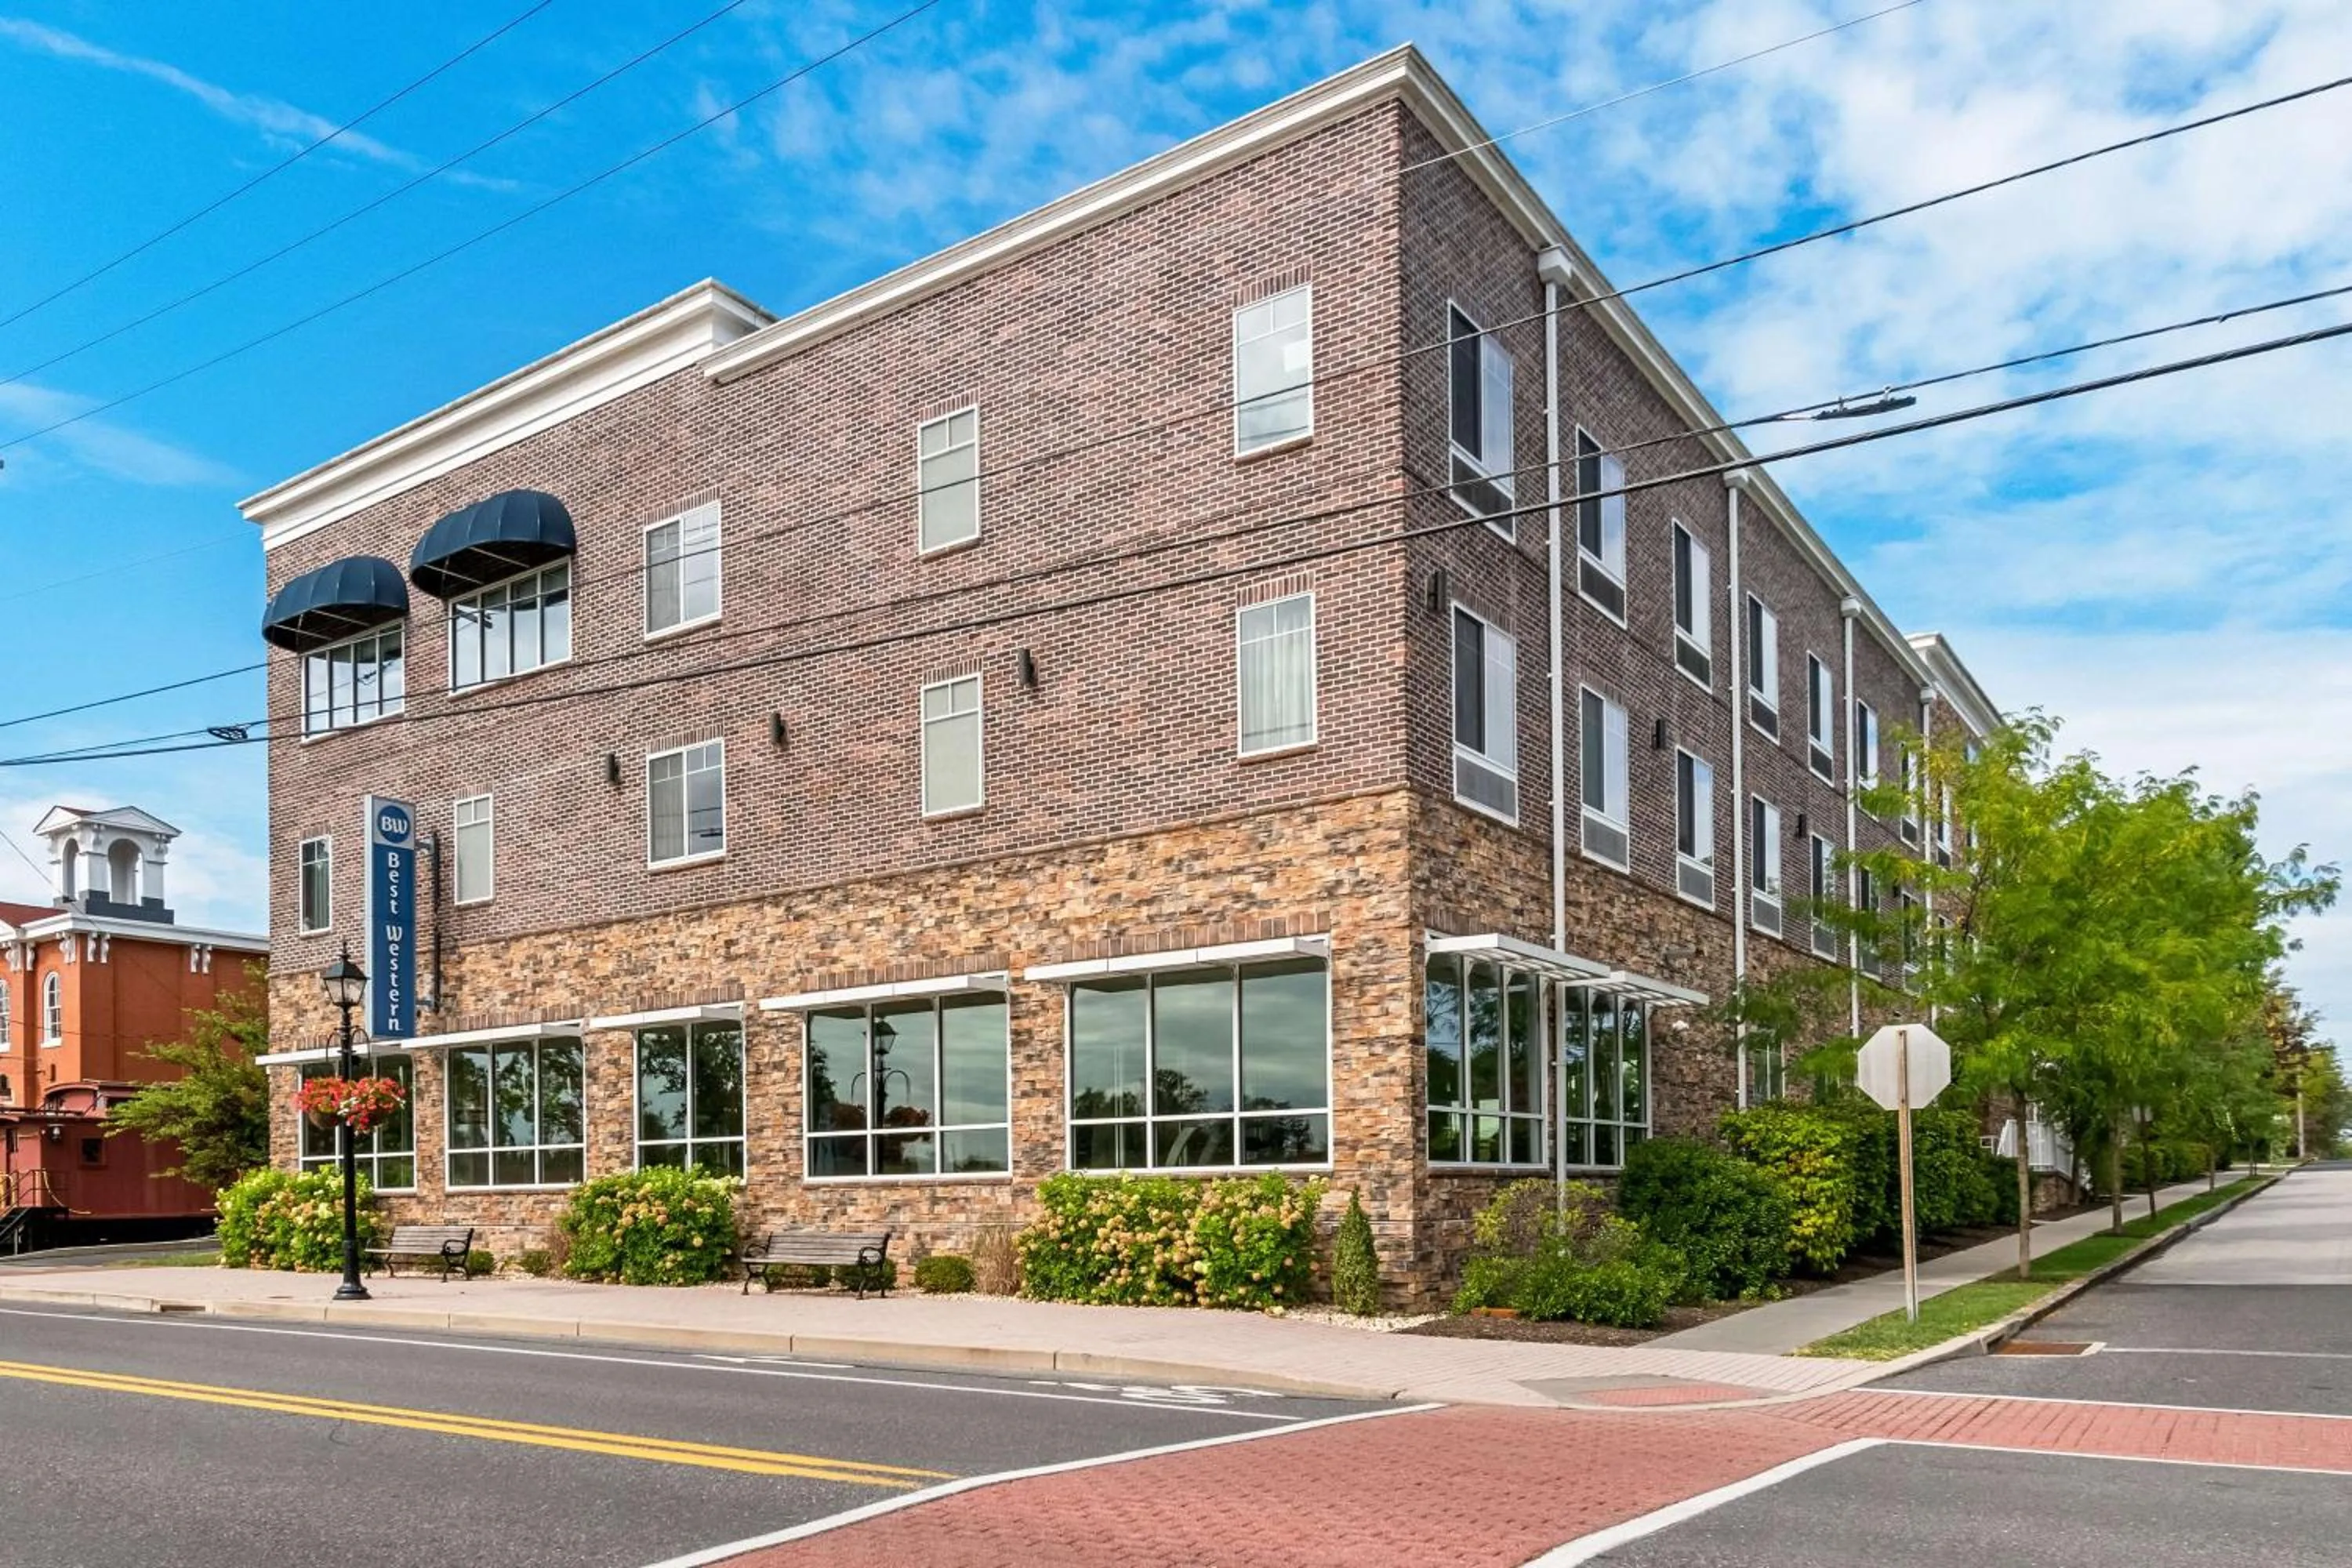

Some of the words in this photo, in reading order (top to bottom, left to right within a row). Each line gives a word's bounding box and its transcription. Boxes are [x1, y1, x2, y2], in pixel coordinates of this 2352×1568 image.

[381, 816, 408, 834] BW
[388, 852, 400, 915] Best
[386, 924, 402, 1031] Western
